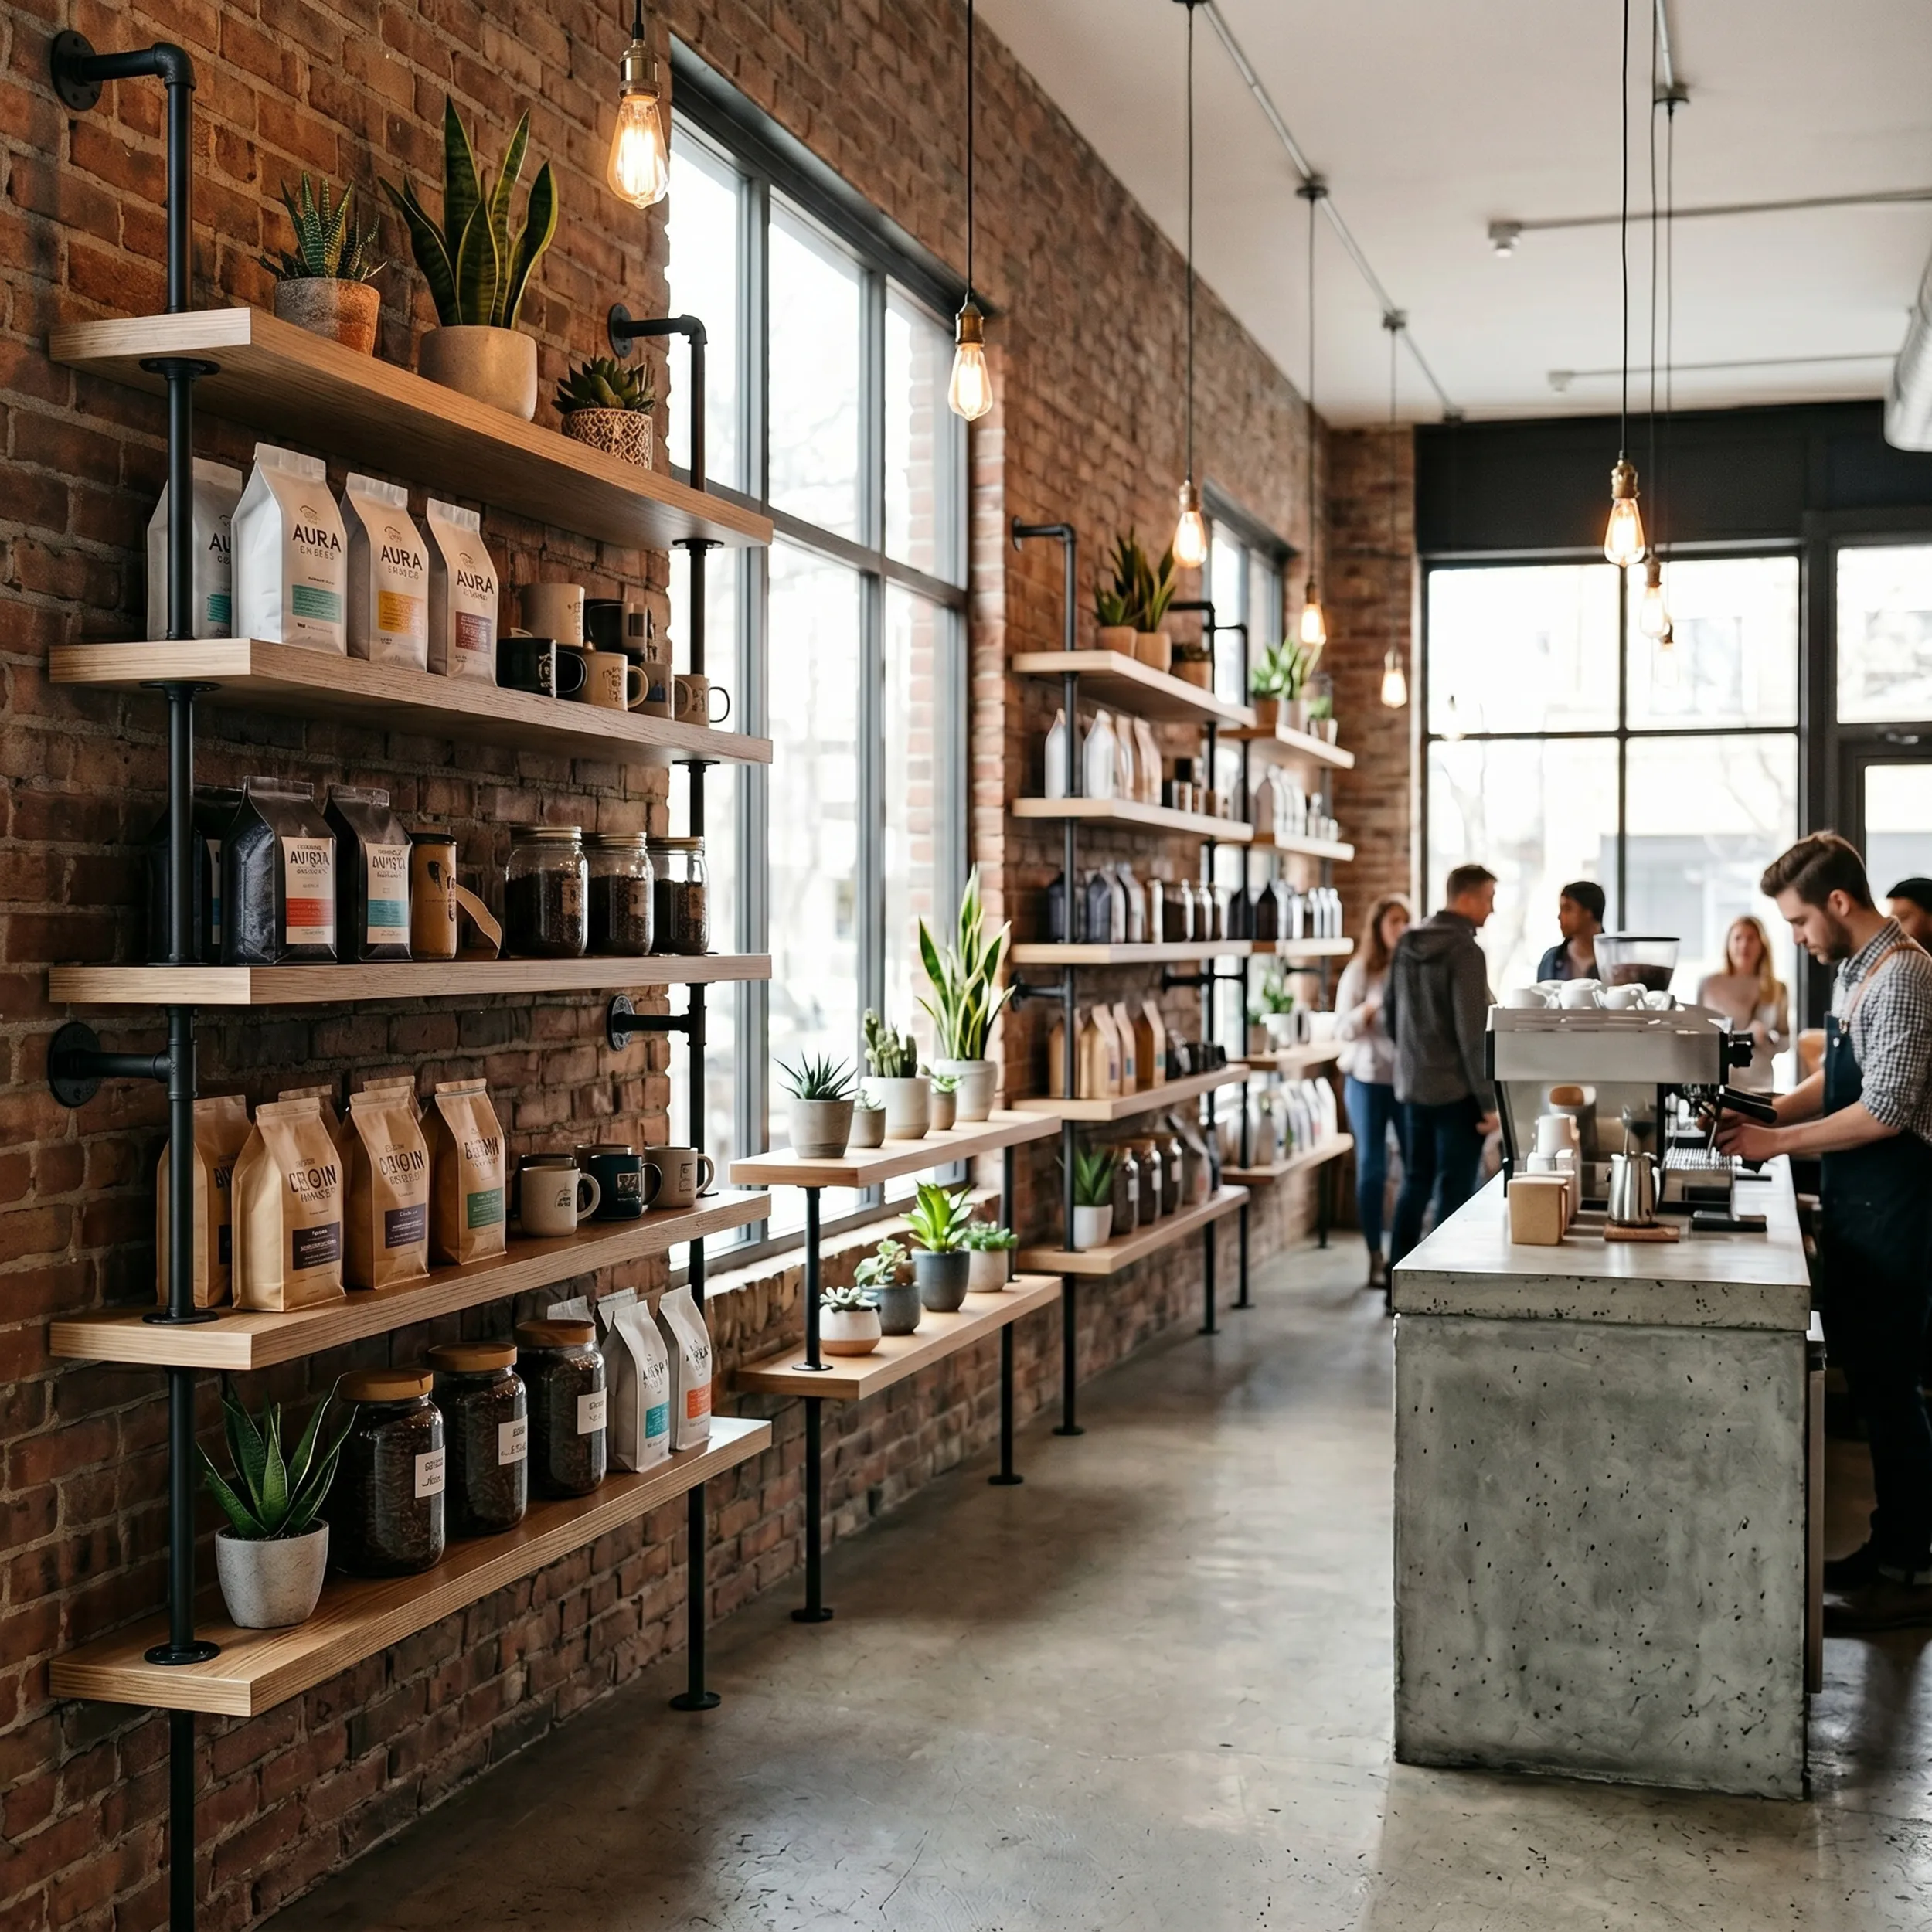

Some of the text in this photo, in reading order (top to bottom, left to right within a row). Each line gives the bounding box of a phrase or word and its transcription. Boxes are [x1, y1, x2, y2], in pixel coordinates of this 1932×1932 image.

[292, 524, 342, 553] AURA
[380, 545, 423, 571] AURA
[457, 569, 494, 594] AURA
